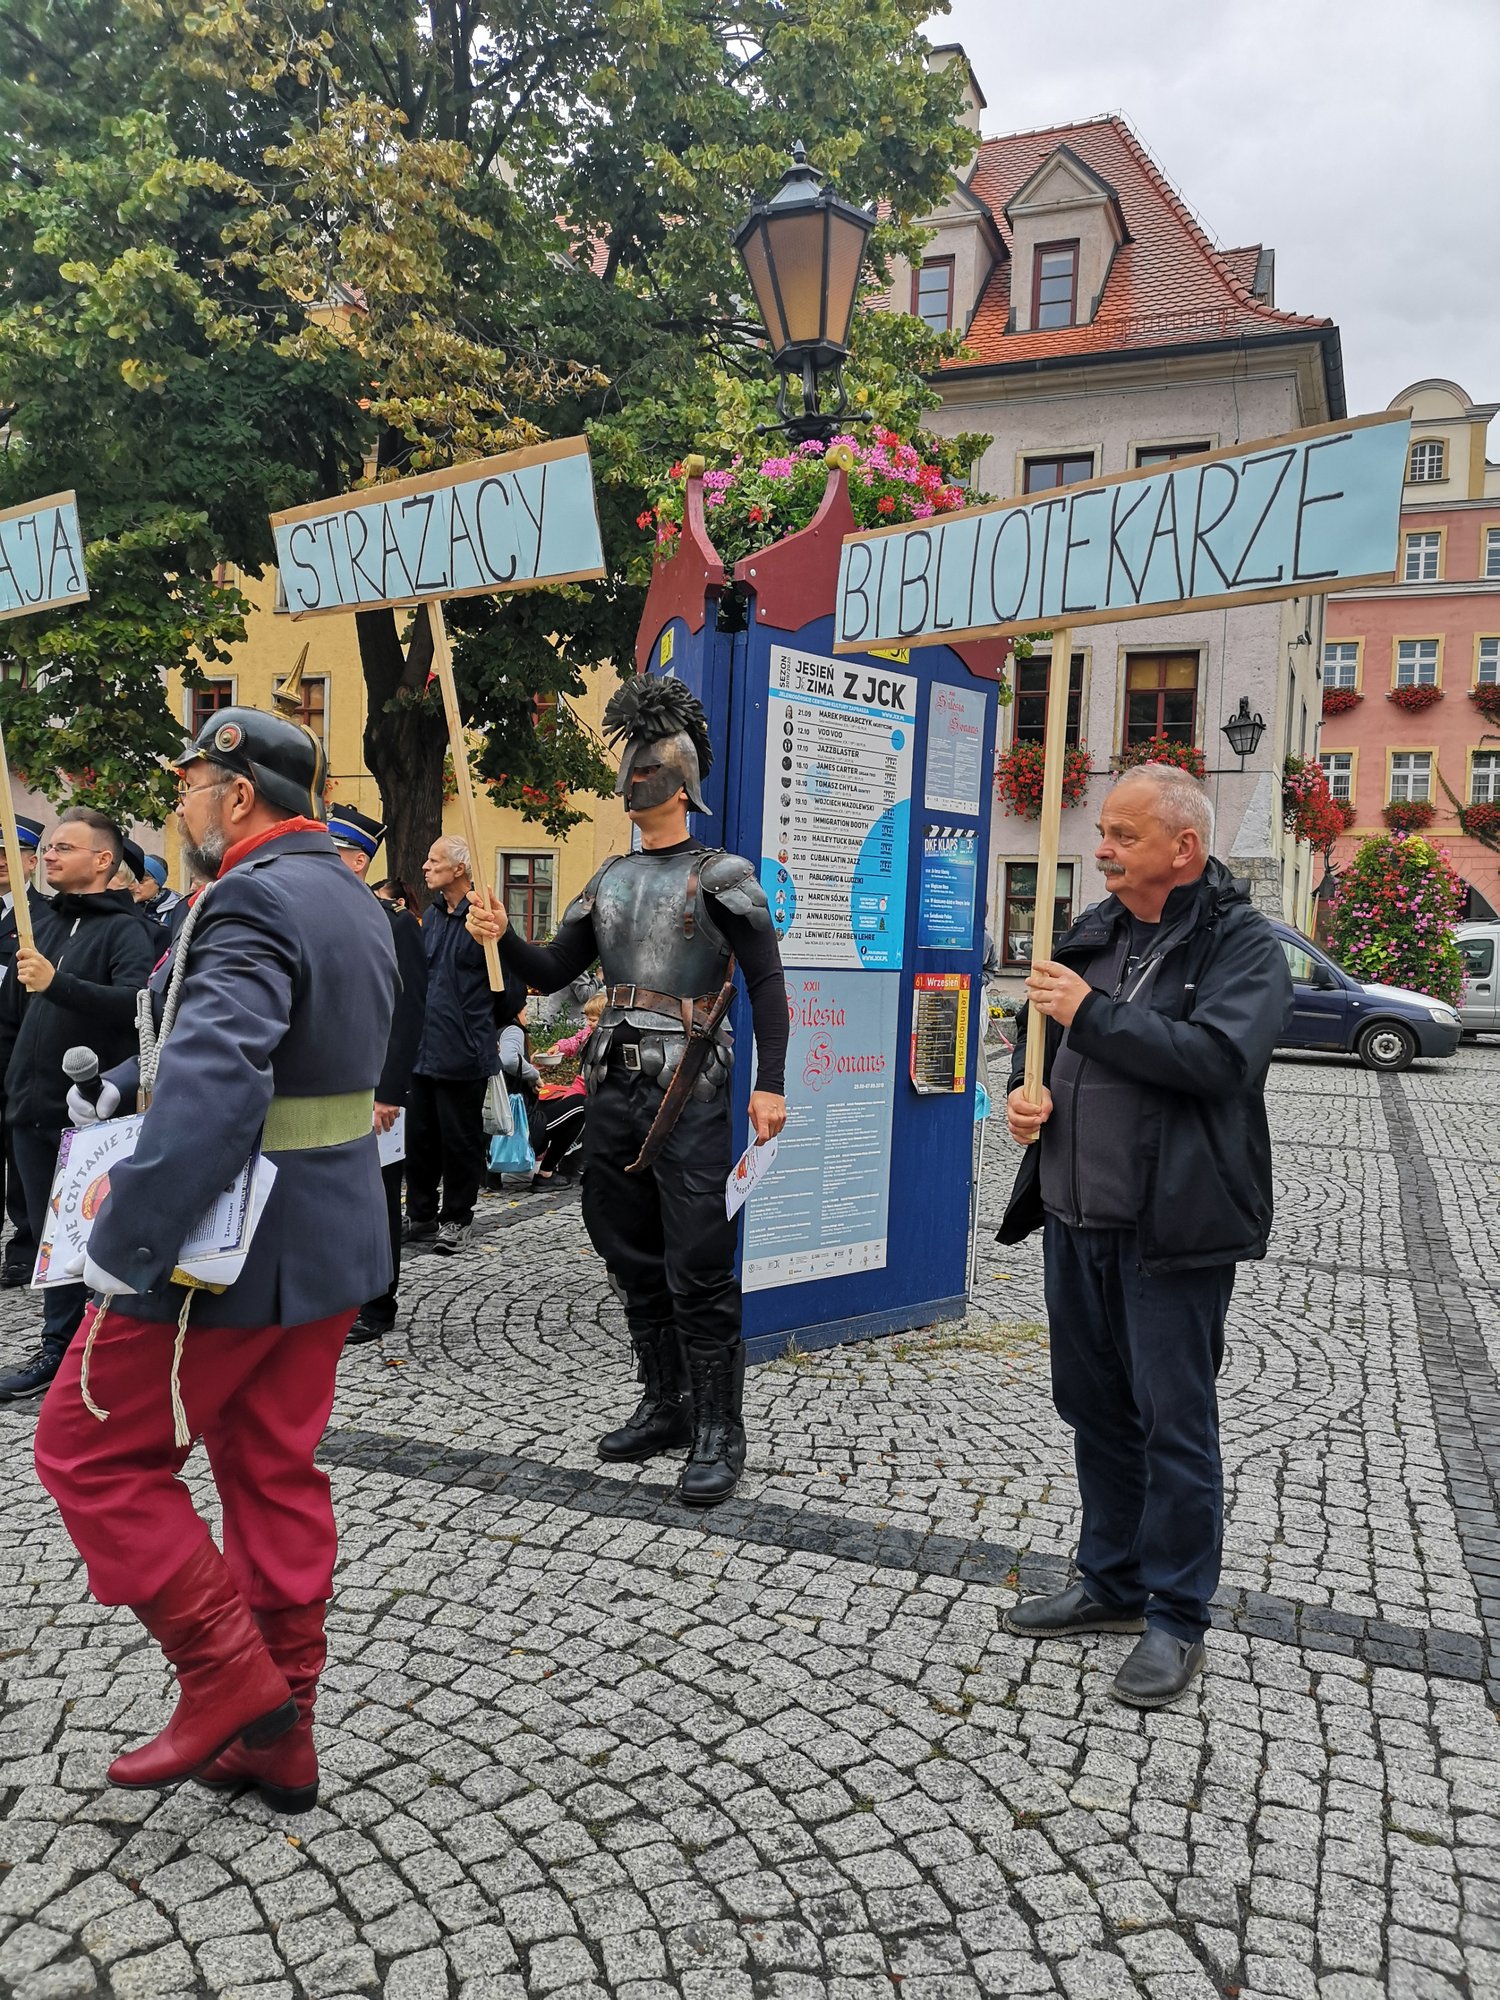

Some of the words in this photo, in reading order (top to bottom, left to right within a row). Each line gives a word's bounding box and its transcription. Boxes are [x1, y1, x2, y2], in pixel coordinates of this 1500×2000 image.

[842, 434, 1353, 642] BIBLIOTEKARZE
[795, 660, 834, 681] JESIEŃ
[807, 679, 834, 697] ZIMA
[843, 672, 859, 701] Z
[862, 677, 906, 711] JCK
[798, 709, 812, 718] 21.09
[819, 710, 839, 720] MAREK
[839, 713, 873, 727] PIEKARCZYK
[797, 727, 810, 735] 12.10
[818, 727, 831, 738] VOO
[831, 730, 843, 739] VOO
[797, 744, 809, 752] 17.10
[817, 744, 860, 758] JAZZBLASTER
[816, 761, 836, 772] JAMES
[836, 764, 859, 775] CARTER
[815, 780, 839, 790] TOMASZ
[814, 797, 841, 807] WOJCIECH
[841, 801, 875, 811] MAZOLEWSKI
[795, 816, 807, 824] 19.10
[813, 816, 848, 827] IMMIGRATION
[848, 820, 869, 830] BOOTH
[794, 834, 807, 842] 20.10
[812, 834, 834, 844] HAILEY
[833, 836, 848, 845] TUCK
[848, 838, 863, 846] BAND
[924, 838, 938, 851] DKF
[938, 838, 958, 851] KLAPS
[793, 853, 806, 861] 20.10
[810, 853, 830, 863] CUBAN
[830, 855, 847, 864] LATIN
[847, 858, 861, 866] JAZZ
[809, 872, 840, 883] PABLOPAVO
[808, 893, 831, 901] MARCIN
[830, 893, 849, 902] SÓJKA
[806, 912, 823, 920] ANNA
[823, 912, 853, 922] RUSOWICZ
[788, 931, 802, 939] 01.02
[804, 930, 832, 939] LENIWIEC
[836, 932, 858, 941] FARBEN
[858, 933, 876, 941] LEHRE
[803, 981, 820, 992] XXII
[915, 977, 925, 987] 61.
[927, 976, 960, 987] Wrzesień
[958, 994, 968, 1067] Jeleniogórski
[802, 1031, 885, 1092] Sonans
[64, 1133, 119, 1214] CZYTANIE
